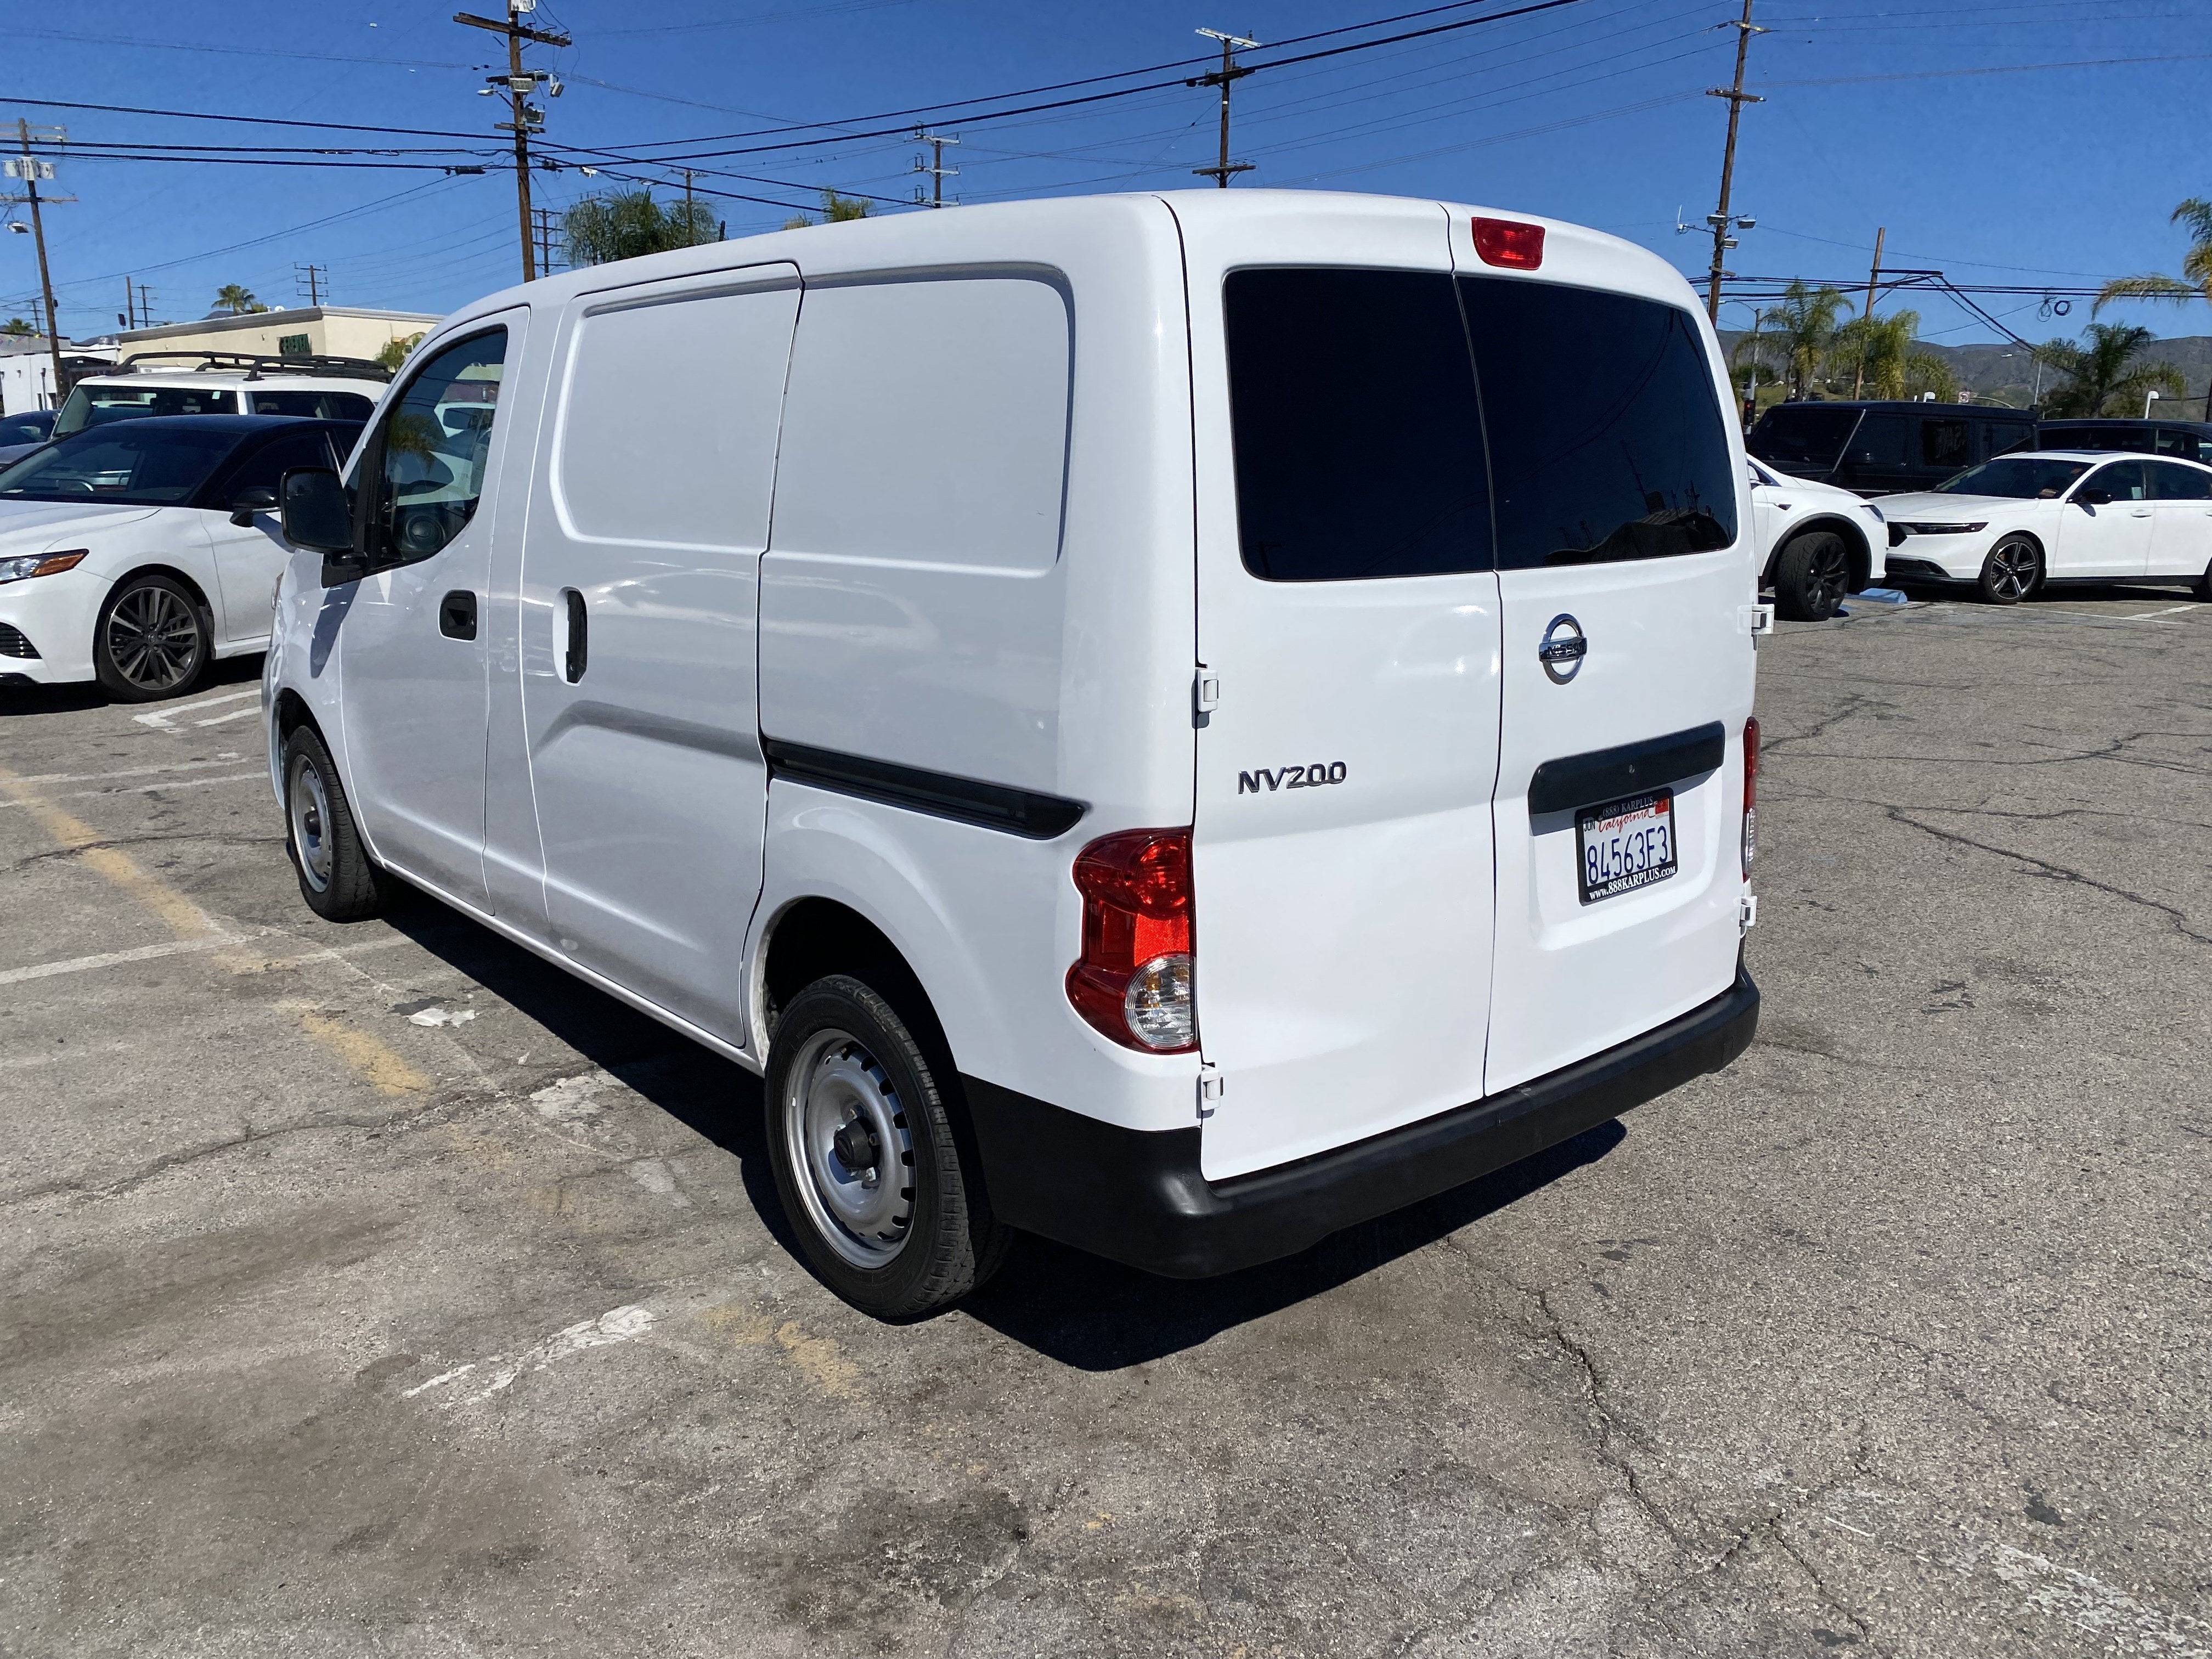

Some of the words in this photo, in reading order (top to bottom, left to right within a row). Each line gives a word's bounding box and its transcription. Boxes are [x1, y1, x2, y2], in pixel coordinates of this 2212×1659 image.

[1238, 761, 1347, 794] NV200
[1602, 805, 1620, 817] (888)
[1621, 796, 1654, 813] KARPLUS
[1587, 825, 1668, 884] 84563F3
